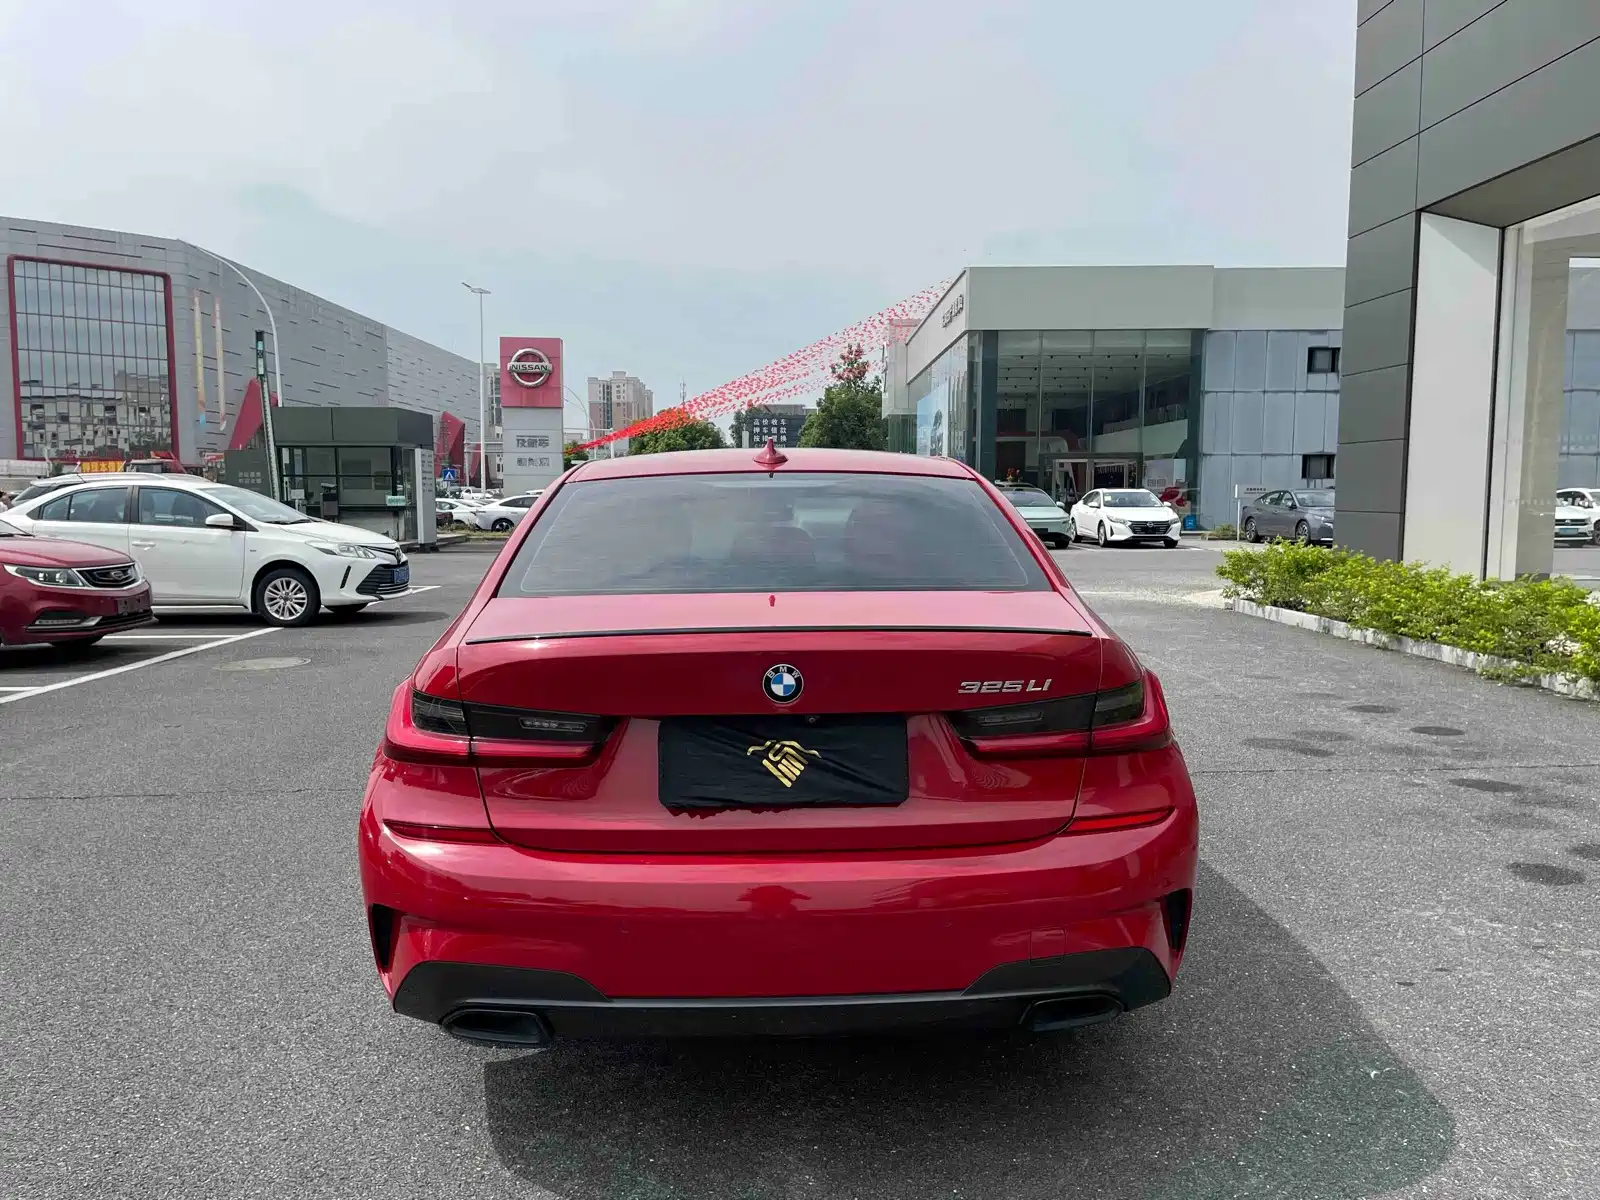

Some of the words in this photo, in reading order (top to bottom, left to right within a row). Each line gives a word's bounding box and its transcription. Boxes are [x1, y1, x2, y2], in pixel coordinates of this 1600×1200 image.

[511, 363, 548, 371] NISSAN
[753, 418, 787, 426] 高价收车
[766, 666, 801, 679] BMW
